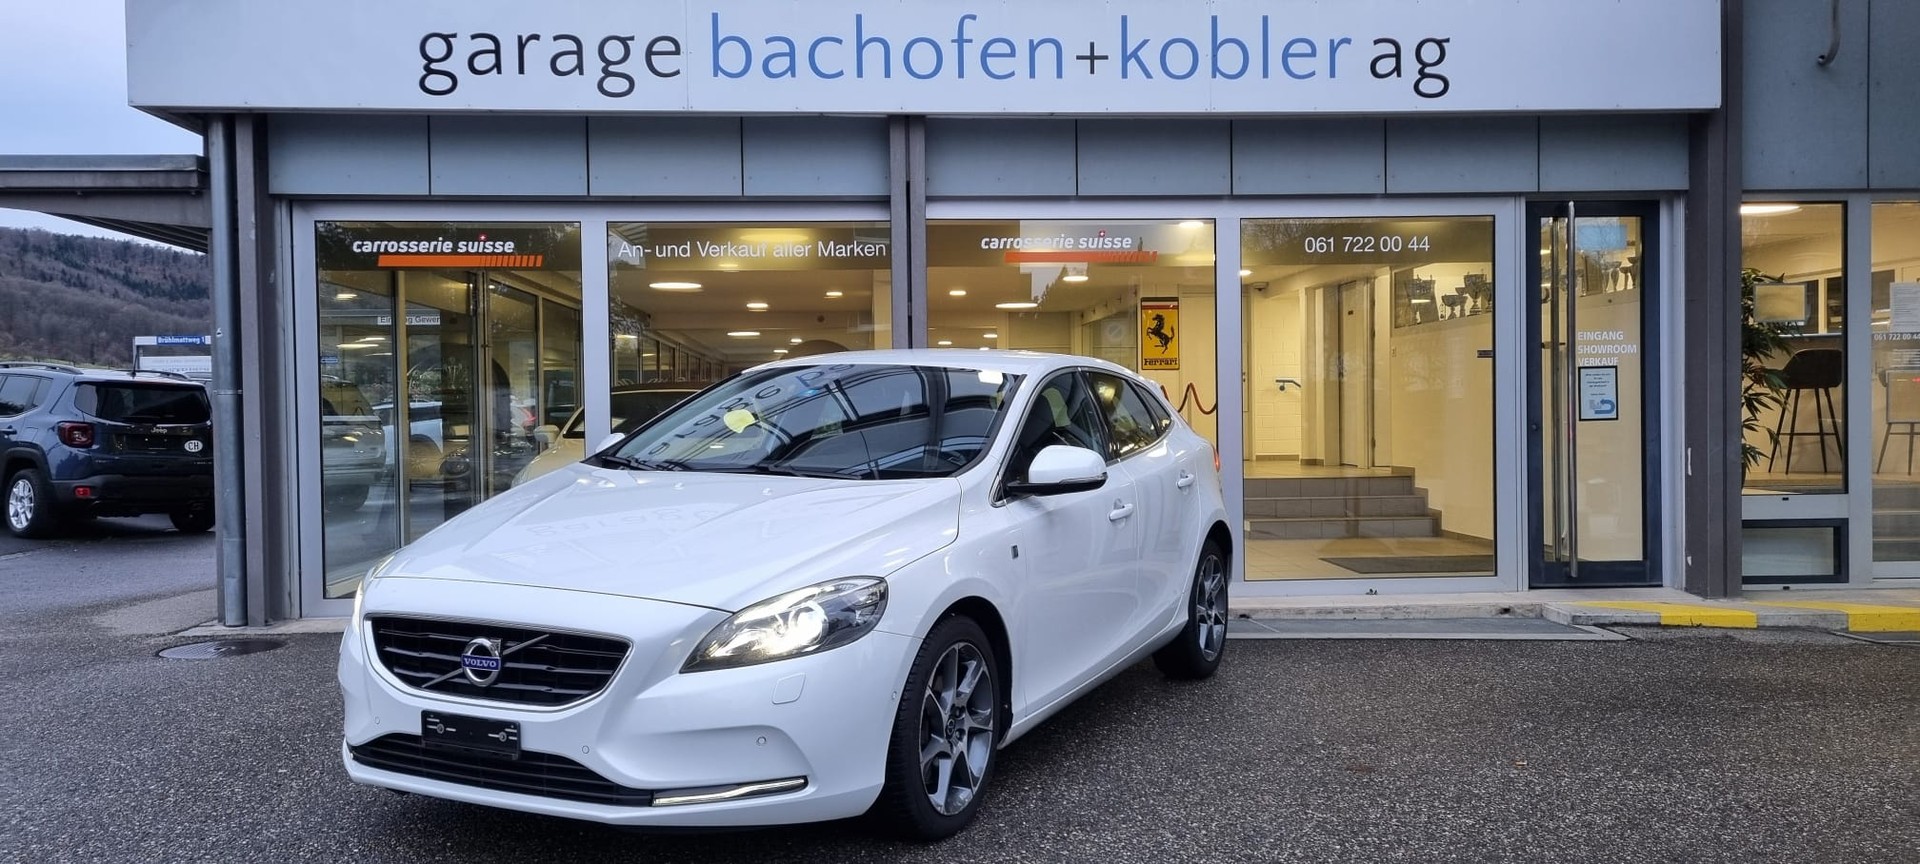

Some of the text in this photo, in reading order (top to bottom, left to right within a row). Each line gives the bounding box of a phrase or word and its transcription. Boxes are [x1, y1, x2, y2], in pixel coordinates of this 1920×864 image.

[418, 31, 682, 98] garage
[1369, 36, 1451, 99] ag
[352, 236, 515, 253] carrosserie suisse
[981, 231, 1132, 250] carrosserie suisse
[1304, 235, 1431, 253] 061 722 00 44
[655, 240, 691, 258] und
[697, 240, 768, 258] Verkauf
[773, 240, 812, 258] aller
[818, 240, 887, 257] Marken
[157, 336, 201, 344] Brühlmattweg
[1578, 331, 1624, 341] EINGANG
[1873, 333, 1887, 341] 061
[1888, 333, 1901, 341] 722
[1902, 333, 1912, 341] 00
[1578, 344, 1637, 354] SHOWROOM
[1143, 357, 1178, 366] Ferrari
[1578, 357, 1619, 366] VERKAUF
[188, 441, 199, 450] CH
[463, 657, 497, 668] VOLVO
